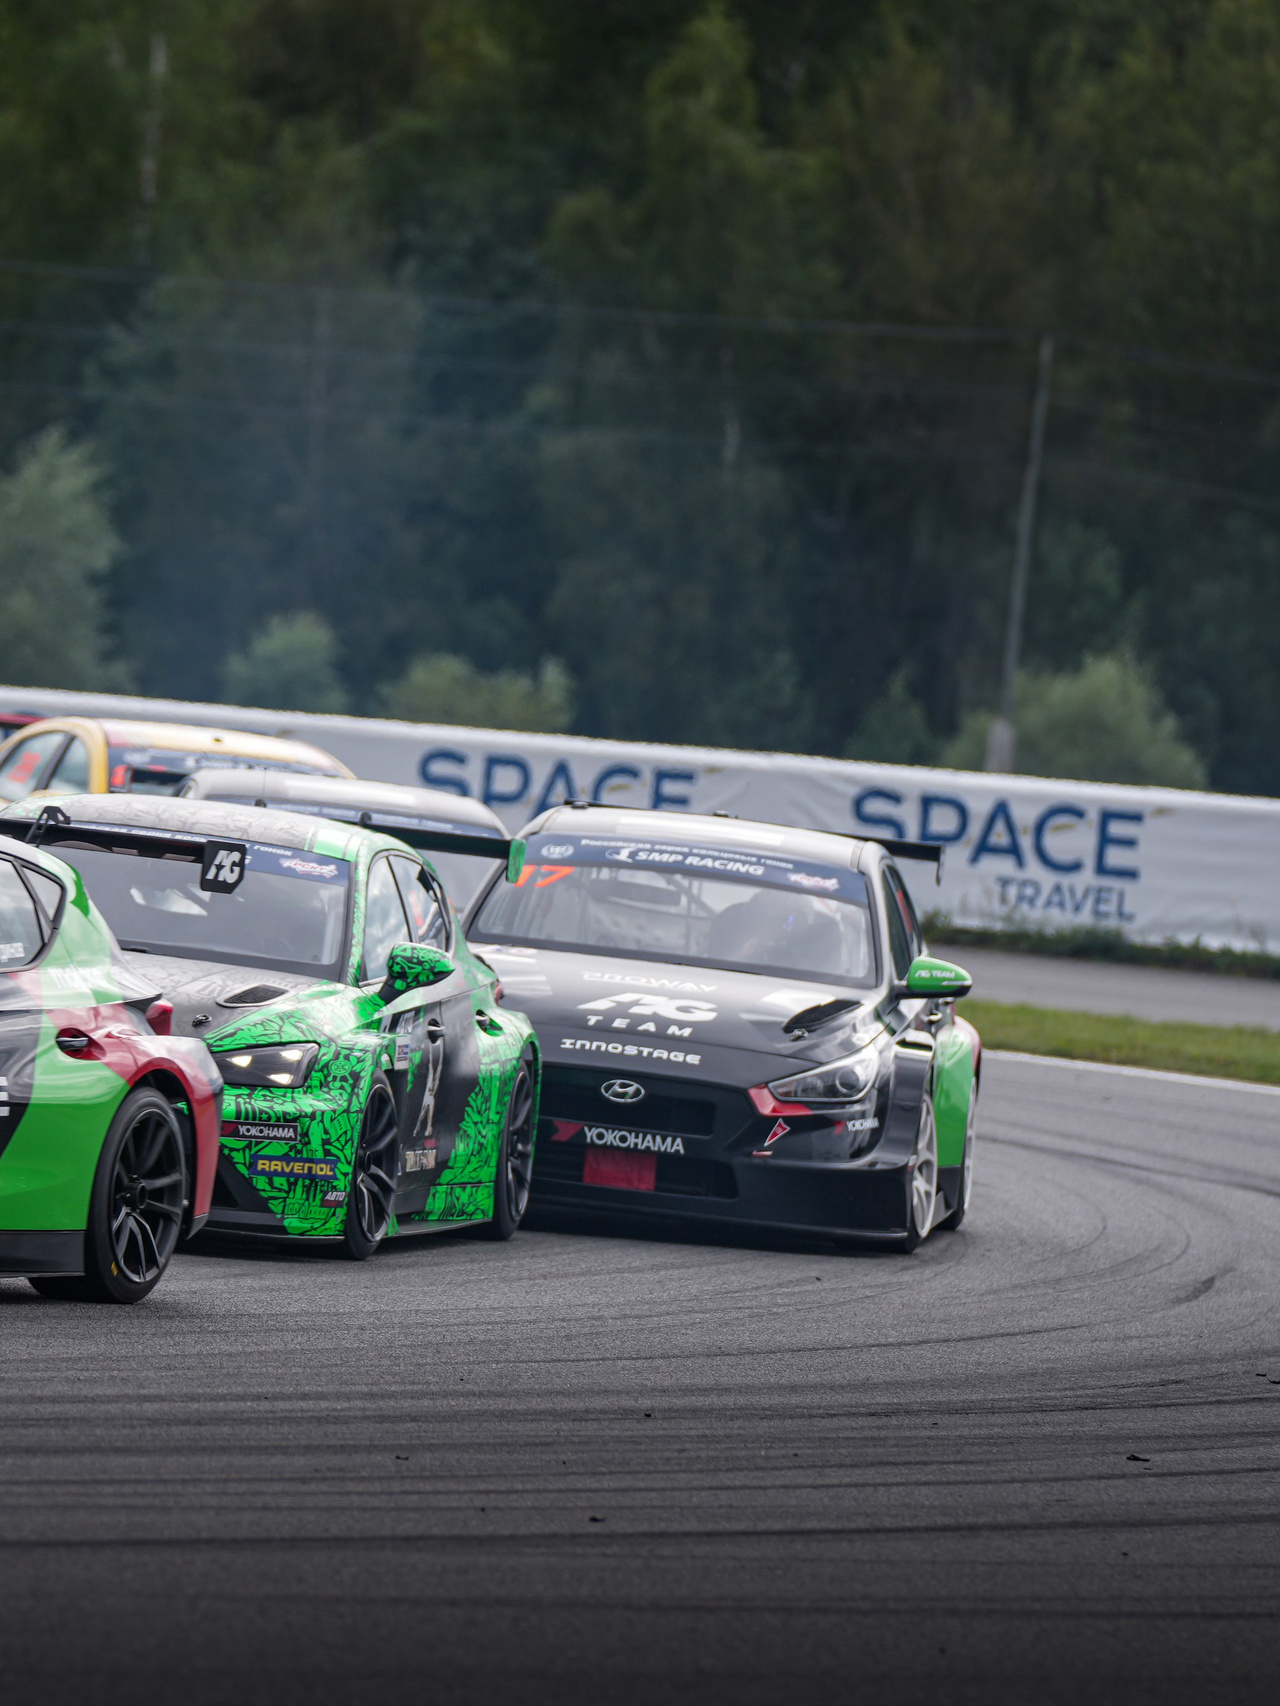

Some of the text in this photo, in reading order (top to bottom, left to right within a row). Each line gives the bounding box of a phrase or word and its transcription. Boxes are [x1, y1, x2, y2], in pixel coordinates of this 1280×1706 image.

[850, 788, 1144, 880] SPACE
[635, 850, 765, 876] SMP RACING
[514, 865, 574, 887] 17
[995, 876, 1135, 923] TRAVEL
[581, 971, 718, 993] PROWAY
[586, 1015, 694, 1037] TEAM
[560, 1038, 702, 1065] INNOSTAGE
[238, 1124, 295, 1139] YOKOHAMA
[583, 1126, 685, 1154] YOKOHAMA
[257, 1159, 333, 1176] RAVENOL
